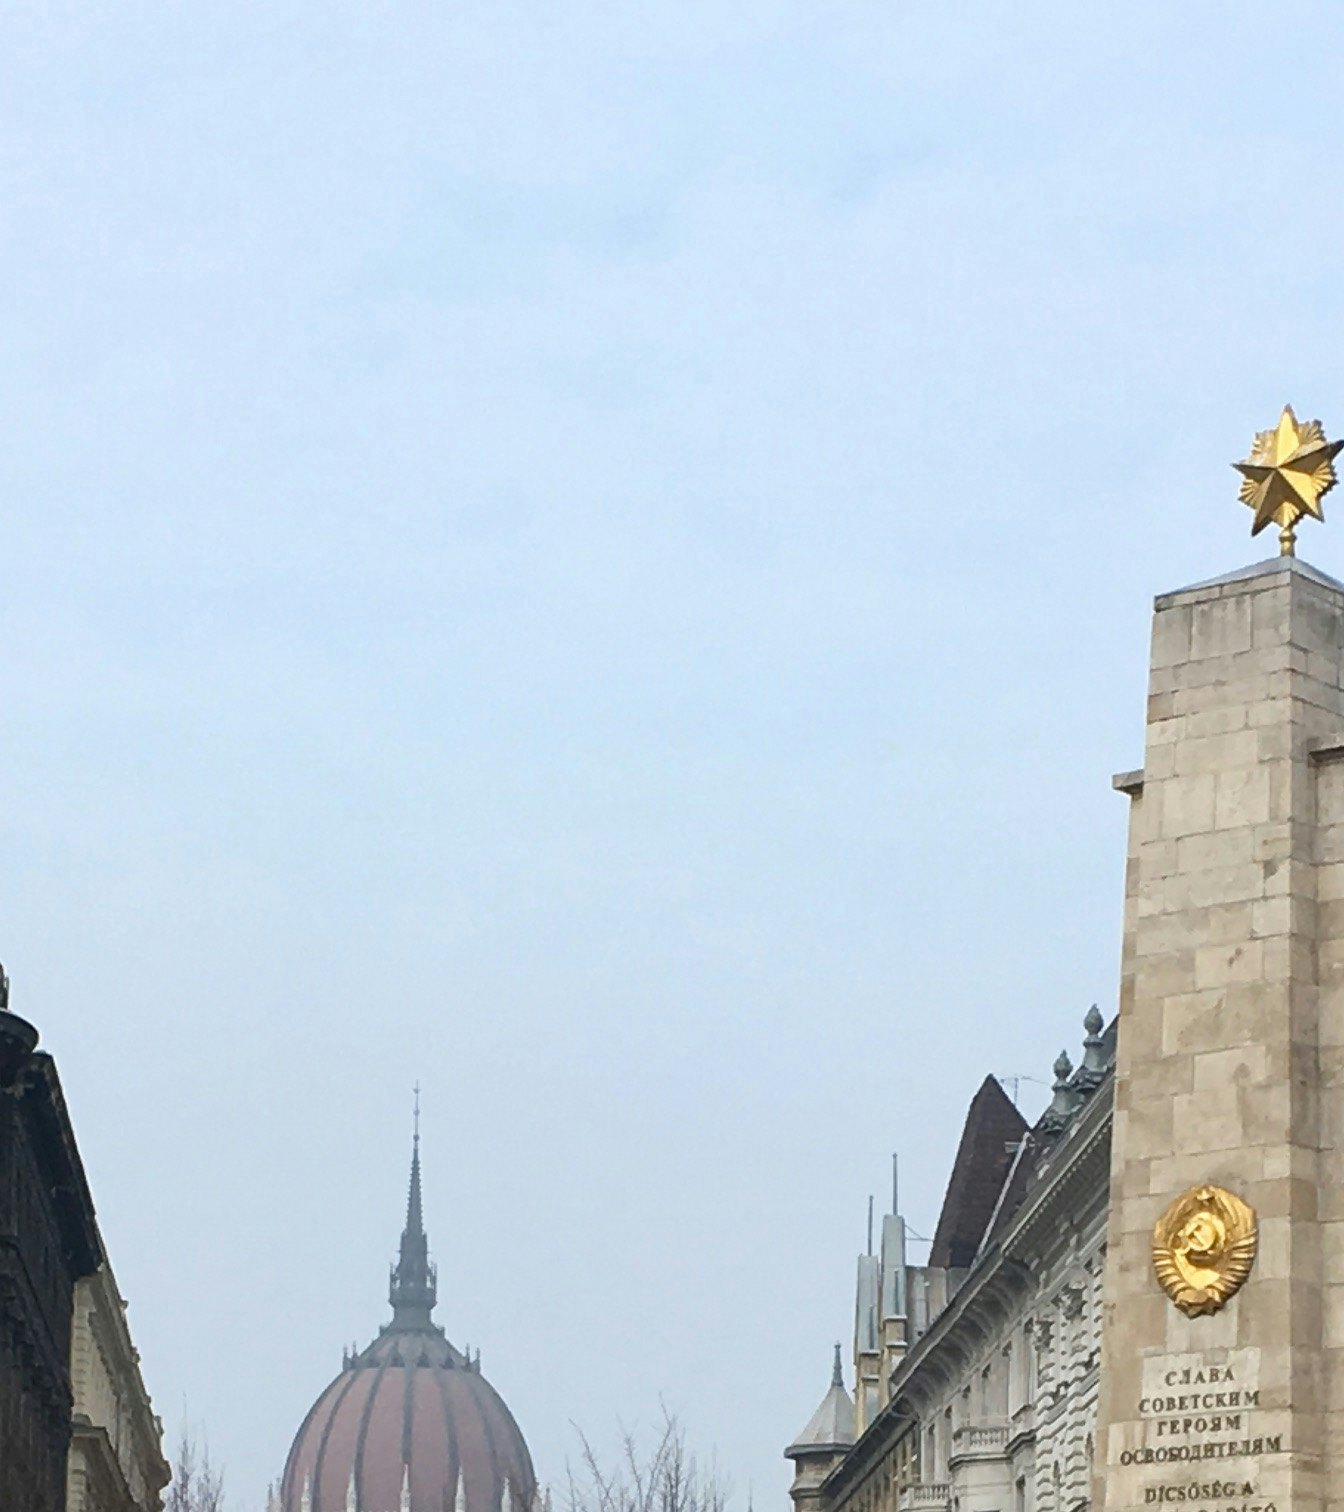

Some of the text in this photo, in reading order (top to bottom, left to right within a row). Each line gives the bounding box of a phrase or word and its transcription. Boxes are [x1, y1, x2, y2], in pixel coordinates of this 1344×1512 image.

[1165, 1368, 1235, 1387] СЛАВА
[1139, 1390, 1260, 1413] СОВЕТСКИМ
[1157, 1415, 1241, 1437] ГЕРОЯМ
[1120, 1435, 1281, 1466] ОСВОБОДИТЕЛЯМ
[1241, 1481, 1254, 1496] A
